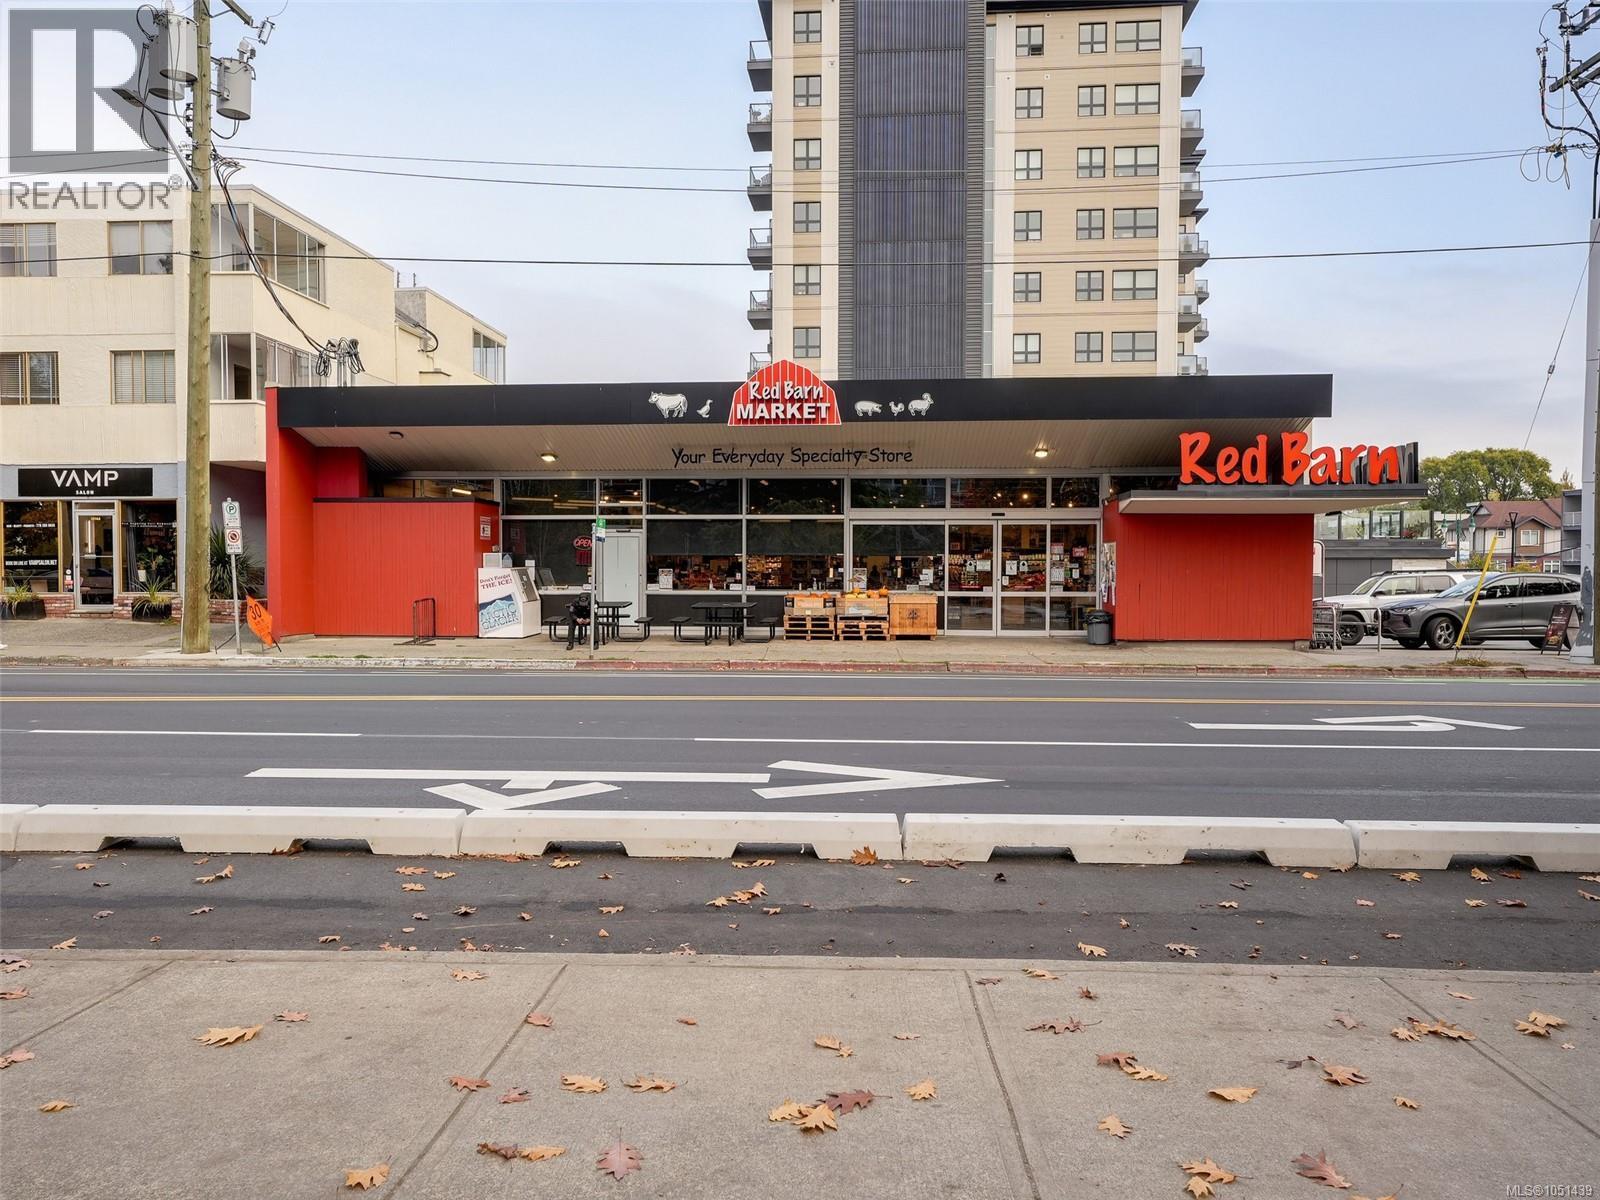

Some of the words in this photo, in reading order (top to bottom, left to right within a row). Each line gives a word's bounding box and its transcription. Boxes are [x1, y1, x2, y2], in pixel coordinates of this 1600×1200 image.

[749, 381, 780, 400] Red
[784, 381, 824, 400] Barn
[736, 402, 831, 420] MARKET
[672, 448, 706, 468] Your
[712, 448, 785, 468] Everyday
[791, 447, 867, 467] Specialty
[868, 447, 913, 463] Store
[1179, 431, 1269, 485] Red
[1281, 431, 1401, 486] Barn
[51, 469, 119, 488] VAMP
[481, 582, 497, 590] THE
[498, 578, 513, 586] ICE!
[249, 603, 262, 620] 30
